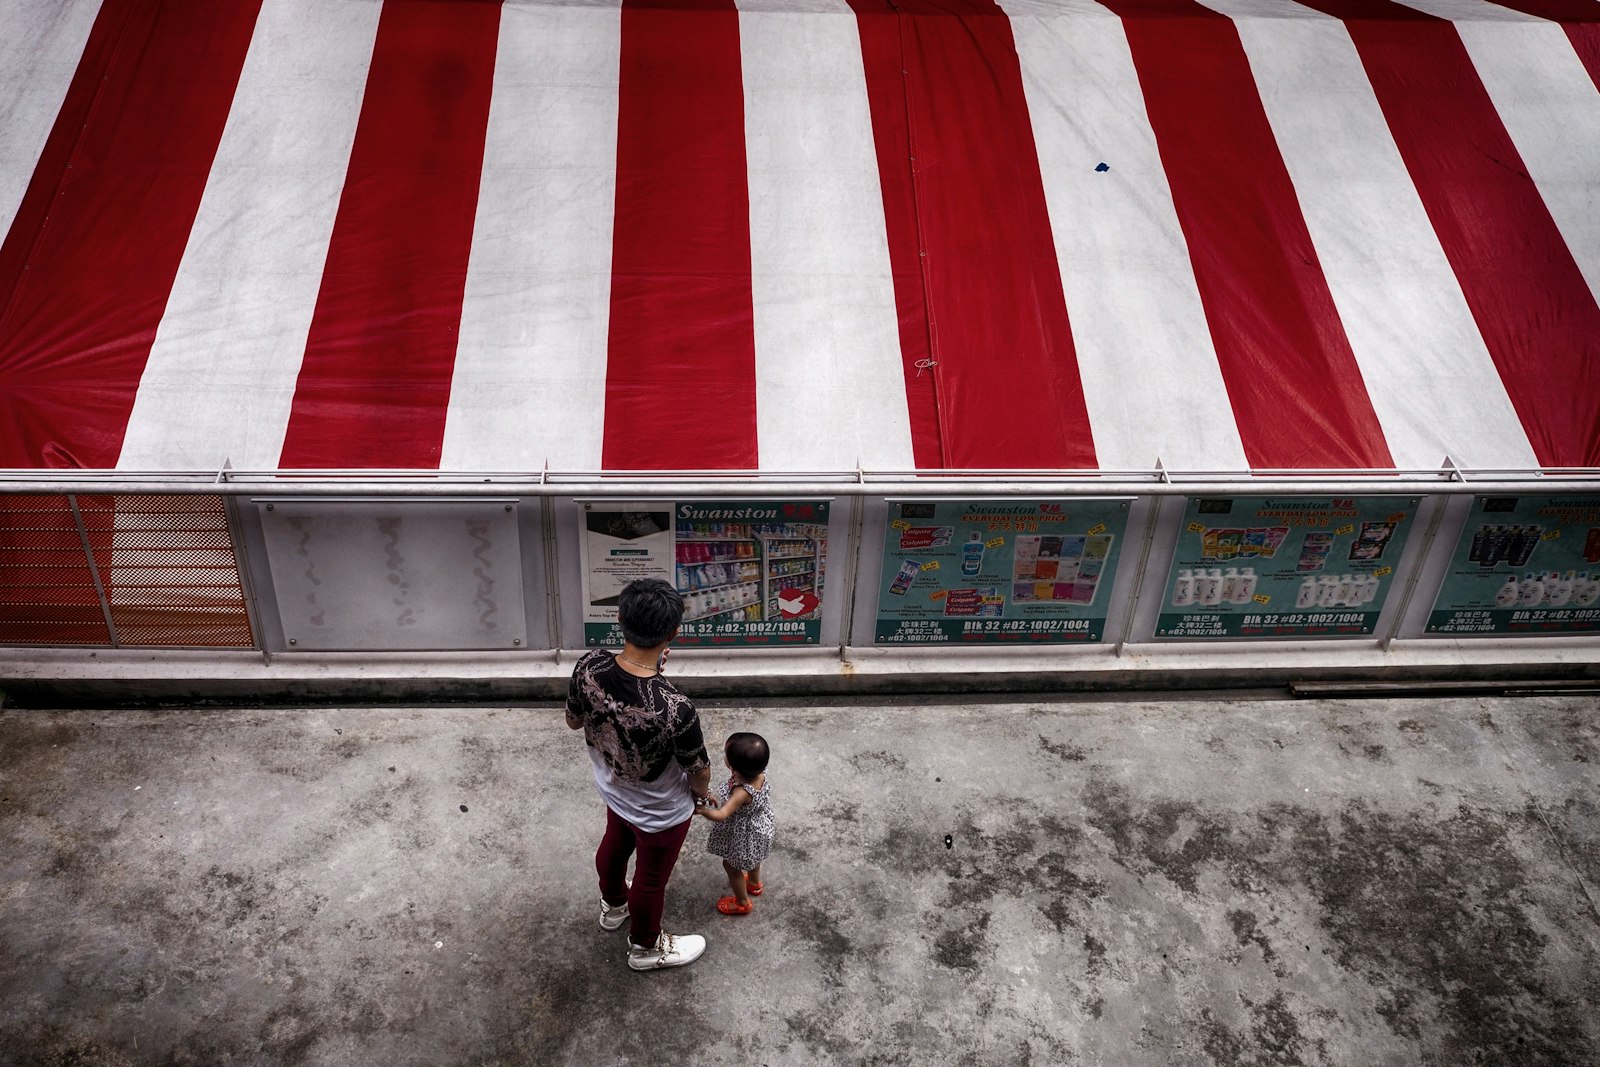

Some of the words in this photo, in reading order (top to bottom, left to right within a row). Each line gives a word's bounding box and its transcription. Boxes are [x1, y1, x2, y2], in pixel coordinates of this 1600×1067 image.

[966, 504, 1036, 514] Swanston
[1262, 500, 1329, 509] Swanston
[677, 504, 778, 520] Swanston
[1280, 614, 1365, 622] #02-1002/1004
[1512, 611, 1530, 619] Blk
[1532, 611, 1547, 619] 32
[678, 624, 695, 633] Blk
[698, 624, 713, 632] 32
[716, 622, 805, 632] #02-1002/1004
[964, 621, 982, 629] Blk
[986, 621, 1000, 629] 32
[1002, 620, 1090, 629] #02-1002/1004
